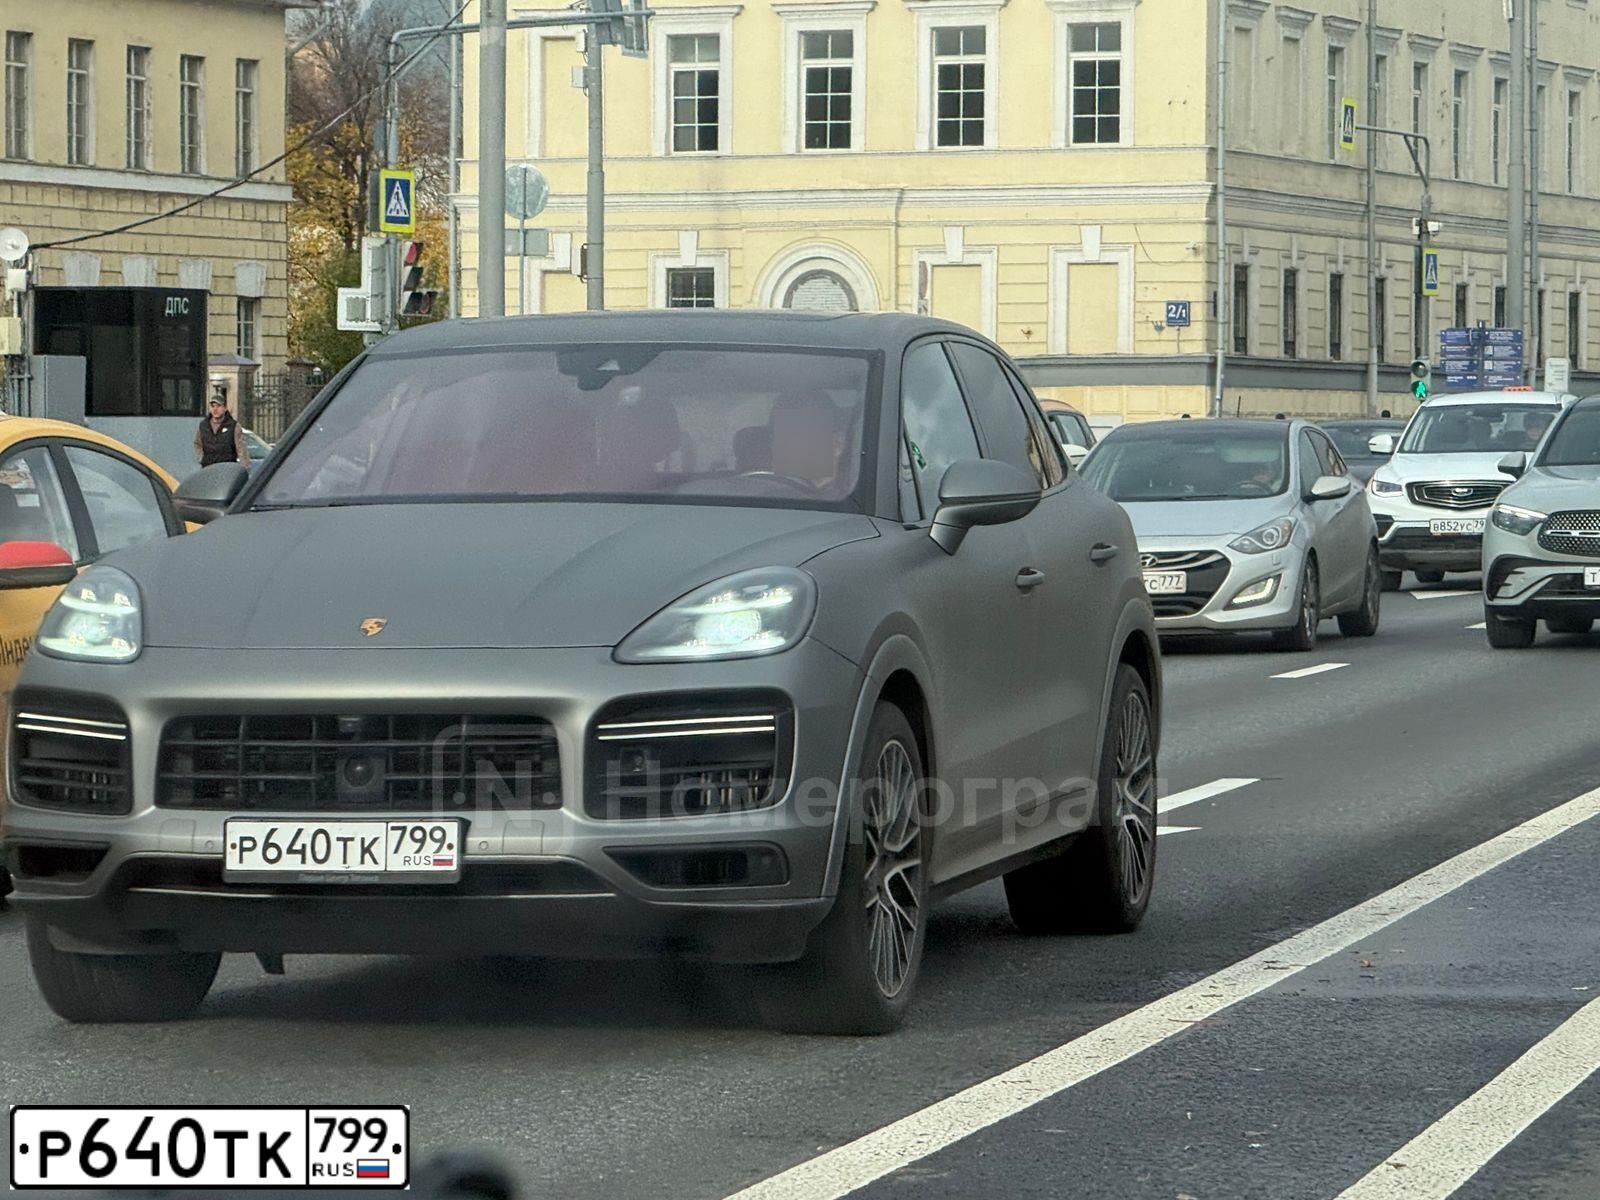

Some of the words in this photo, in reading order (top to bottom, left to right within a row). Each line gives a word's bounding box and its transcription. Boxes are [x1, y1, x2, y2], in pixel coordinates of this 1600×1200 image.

[165, 297, 189, 317] ДПС
[1168, 304, 1186, 319] 2/1
[239, 827, 381, 866] Р640ТК
[389, 825, 447, 855] 799
[403, 855, 431, 866] RUS
